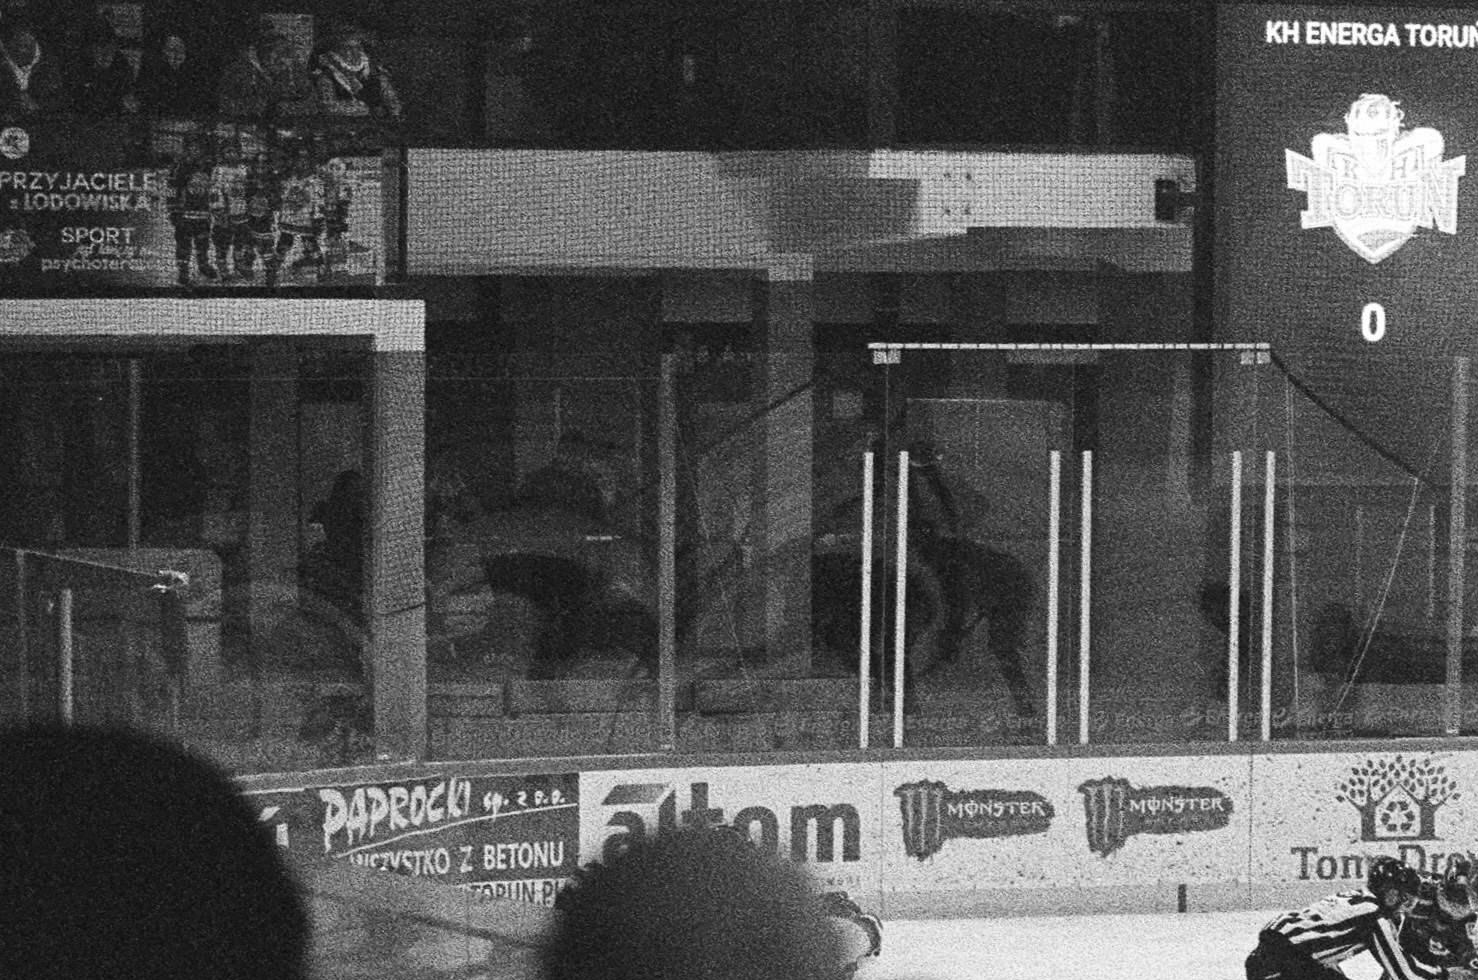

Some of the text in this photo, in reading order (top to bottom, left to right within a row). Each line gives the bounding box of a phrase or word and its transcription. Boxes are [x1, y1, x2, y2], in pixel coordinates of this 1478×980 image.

[1266, 20, 1300, 45] KH
[1306, 21, 1401, 47] ENERGA
[0, 171, 157, 191] PRZYJACIELE
[61, 227, 136, 245] SPORT
[1361, 302, 1387, 342] 0
[946, 799, 1047, 819] MONSTER
[1129, 795, 1225, 815] MONSTER
[459, 844, 474, 874] Z
[483, 841, 564, 870] BETONU
